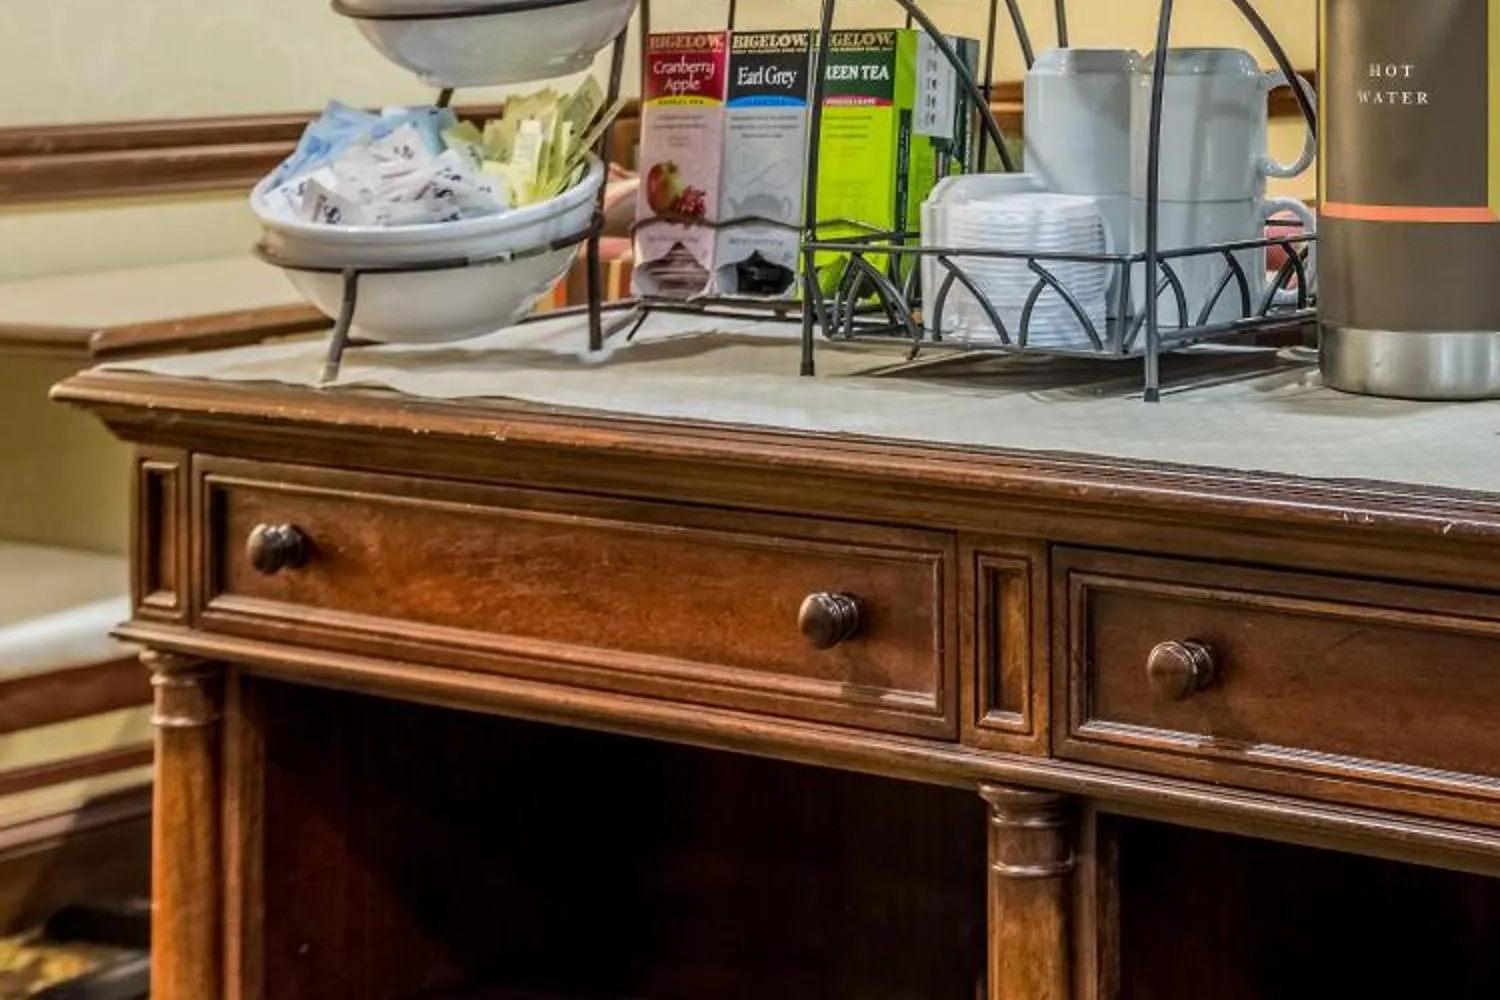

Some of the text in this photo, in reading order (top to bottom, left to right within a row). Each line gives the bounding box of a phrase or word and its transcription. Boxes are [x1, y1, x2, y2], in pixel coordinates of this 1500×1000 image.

[732, 33, 808, 48] BIGELOW
[653, 55, 715, 80] Cranberry
[824, 64, 889, 81] REEN TEA
[1369, 62, 1415, 77] HOT
[663, 71, 700, 96] Apple
[737, 65, 797, 88] Earl Grey
[1357, 90, 1429, 105] WATER
